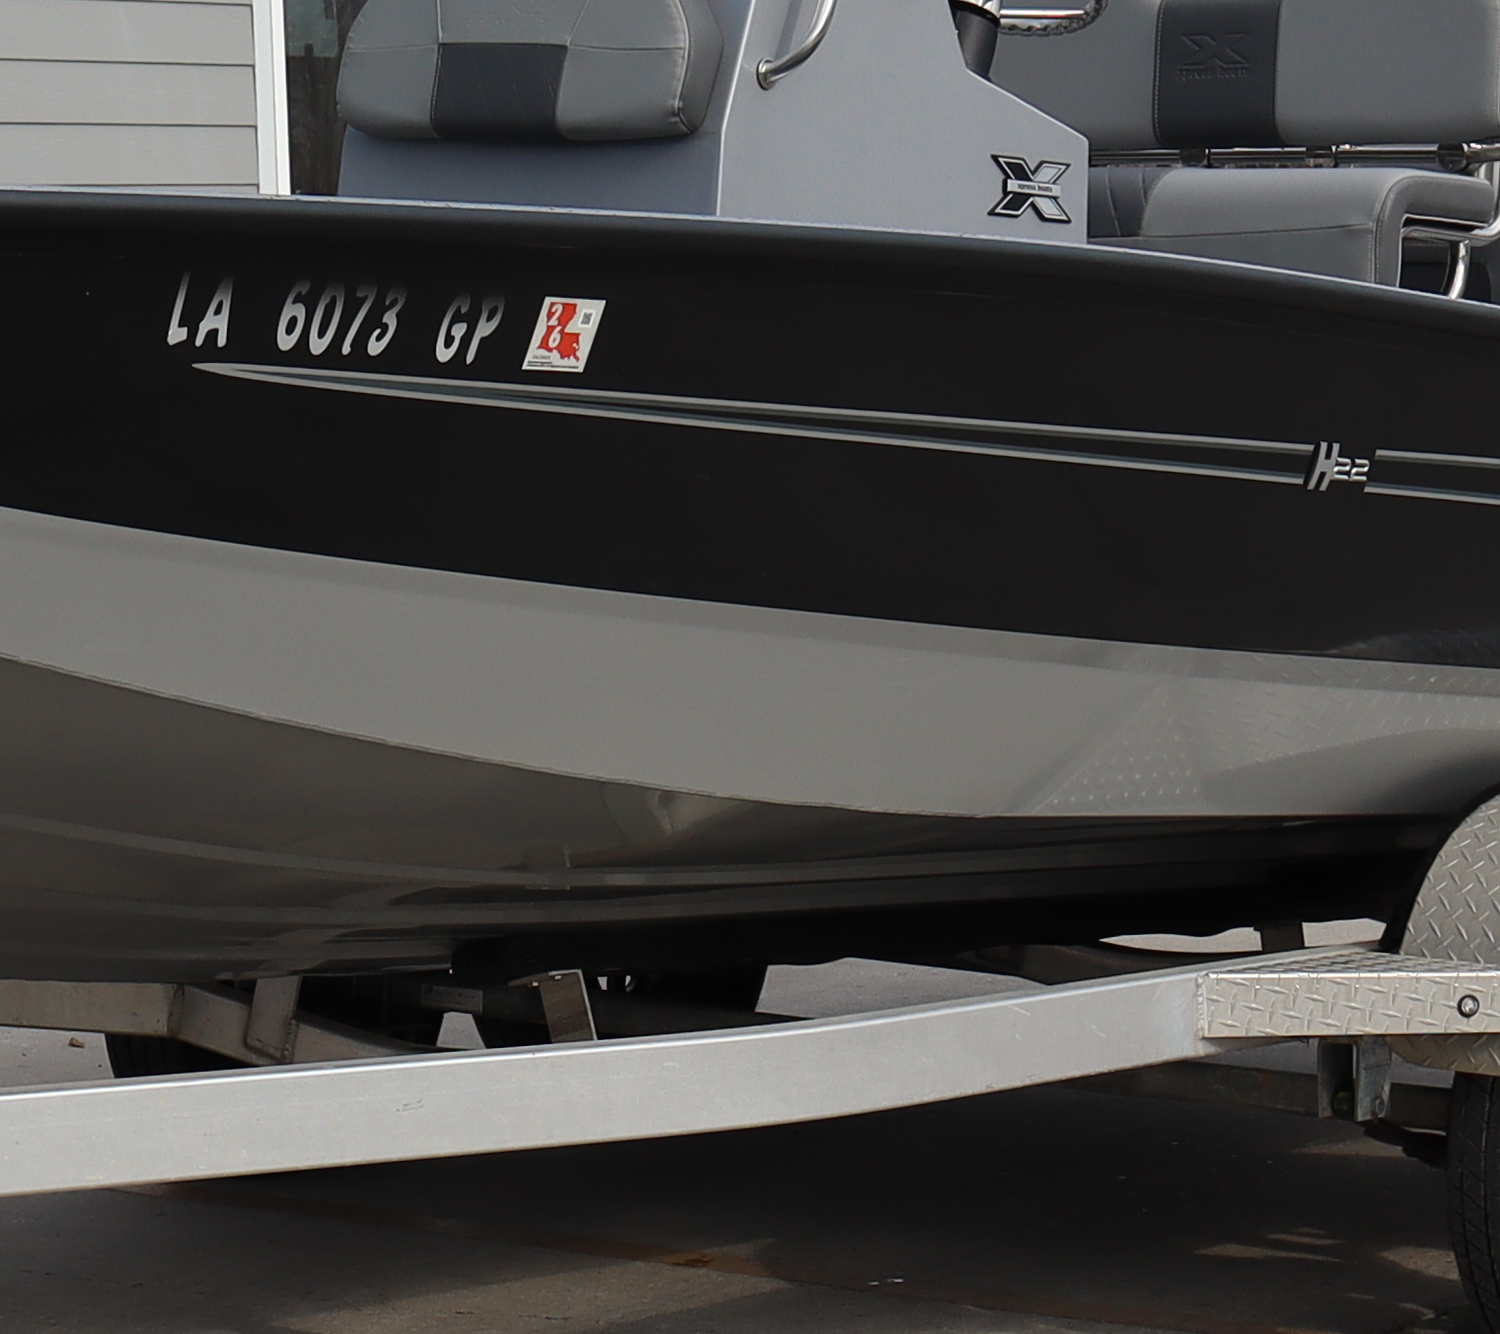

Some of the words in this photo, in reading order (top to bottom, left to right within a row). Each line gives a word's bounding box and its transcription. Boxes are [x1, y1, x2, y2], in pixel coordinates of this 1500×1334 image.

[166, 270, 234, 348] LA
[275, 278, 409, 357] 6073
[435, 291, 506, 366] GP
